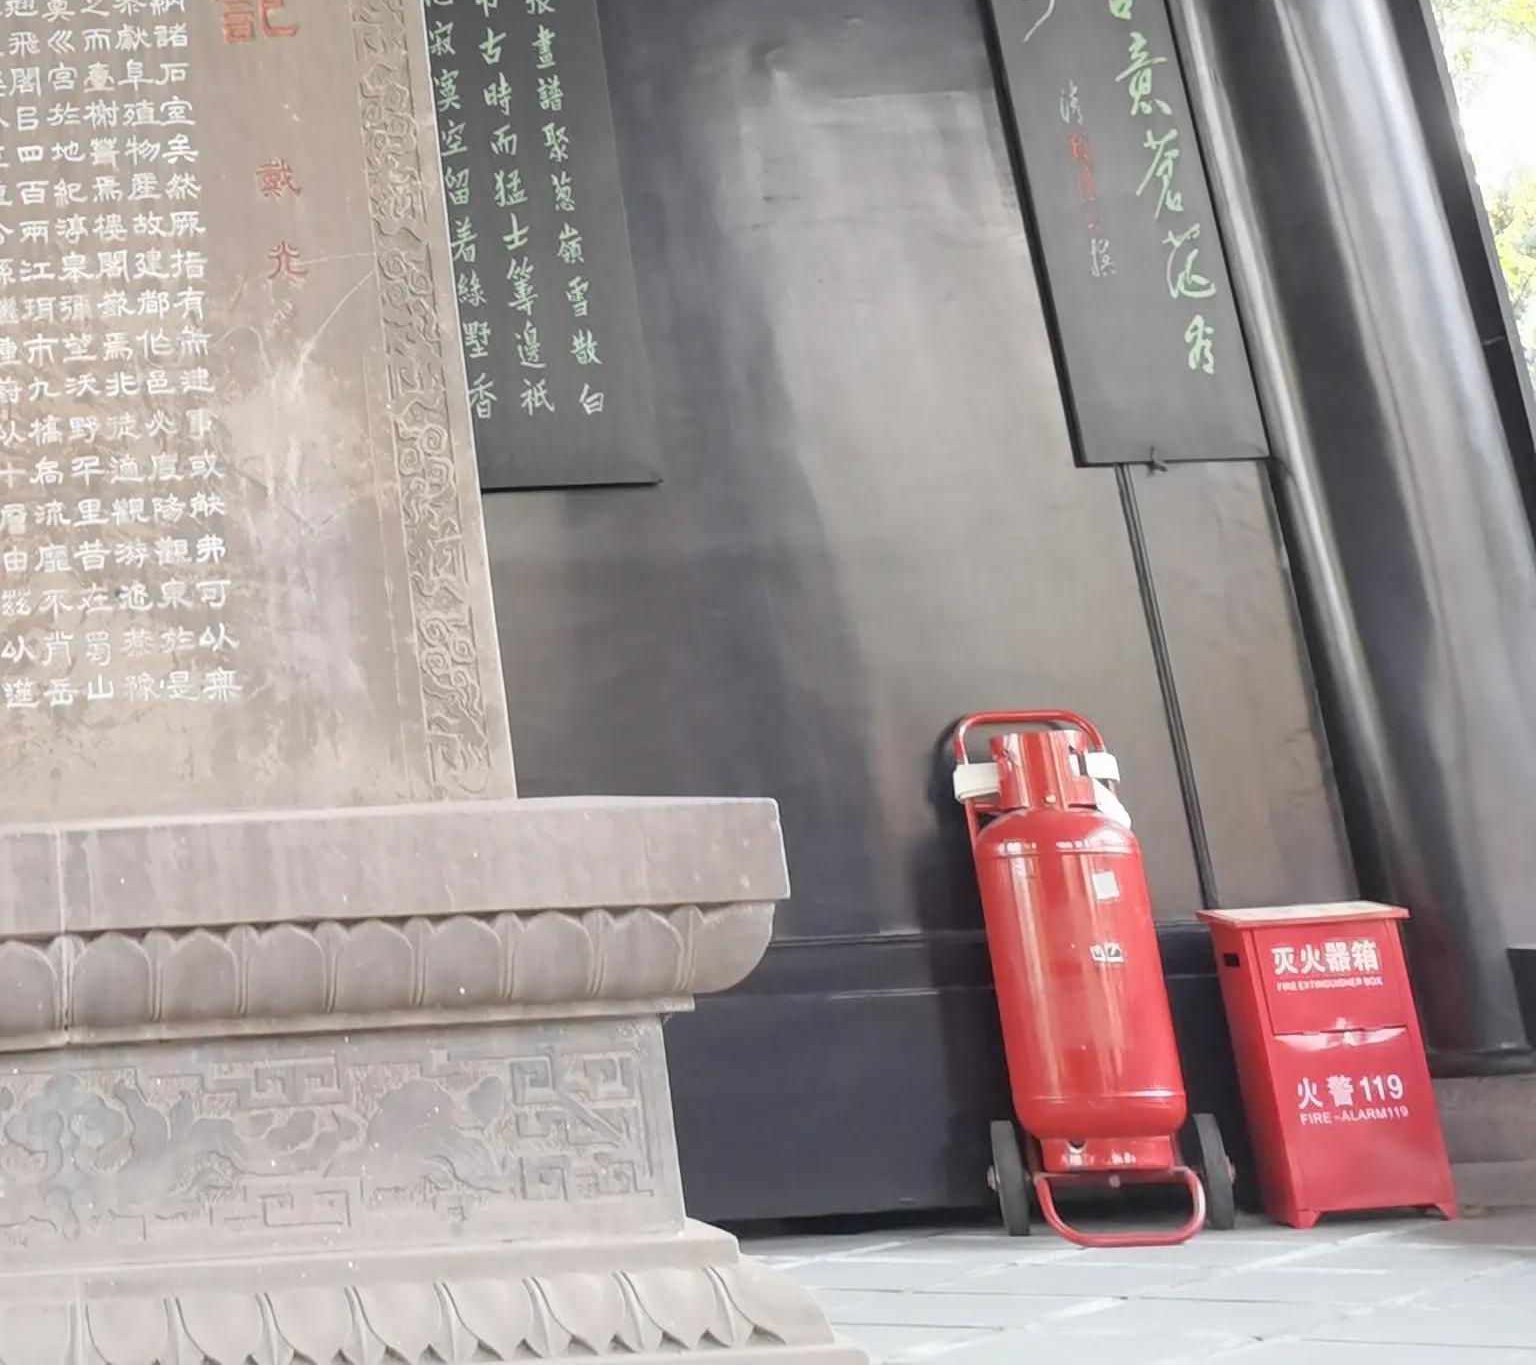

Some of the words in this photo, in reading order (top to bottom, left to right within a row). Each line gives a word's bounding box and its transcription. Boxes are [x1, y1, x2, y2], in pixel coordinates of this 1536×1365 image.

[1271, 938, 1380, 975] 灭火器箱
[1363, 975, 1383, 987] BOX
